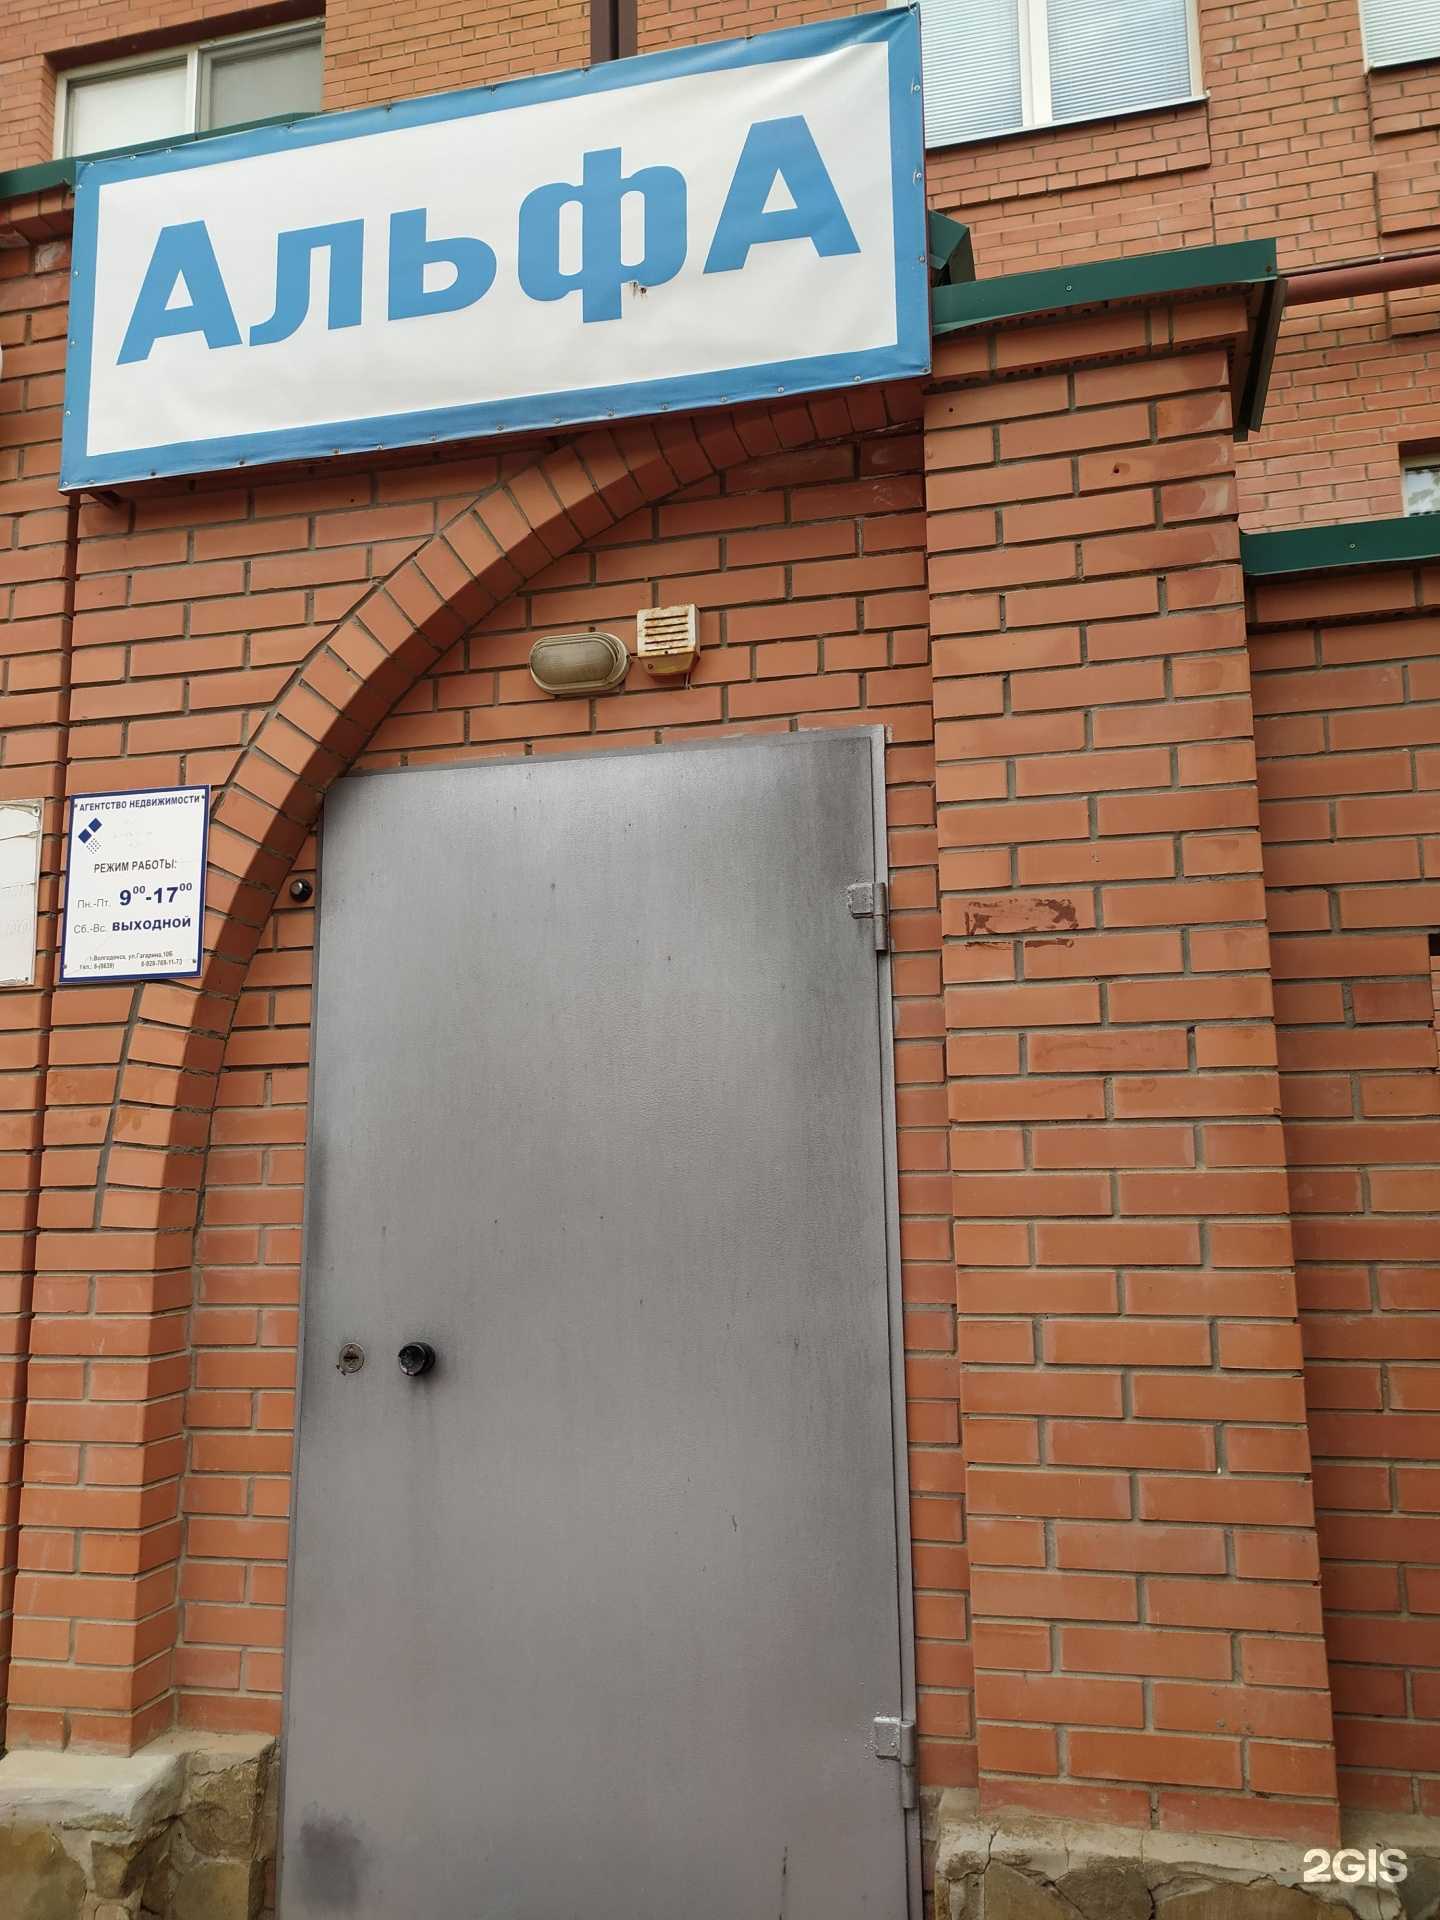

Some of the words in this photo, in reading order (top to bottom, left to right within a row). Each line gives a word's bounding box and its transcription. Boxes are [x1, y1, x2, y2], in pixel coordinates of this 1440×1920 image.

[79, 800, 127, 811] АГЕНТСТВО
[129, 795, 200, 808] НЕДВИЖИМОСТИ
[94, 861, 129, 874] РЕЖИМ
[131, 858, 177, 871] РАБОТЫ:
